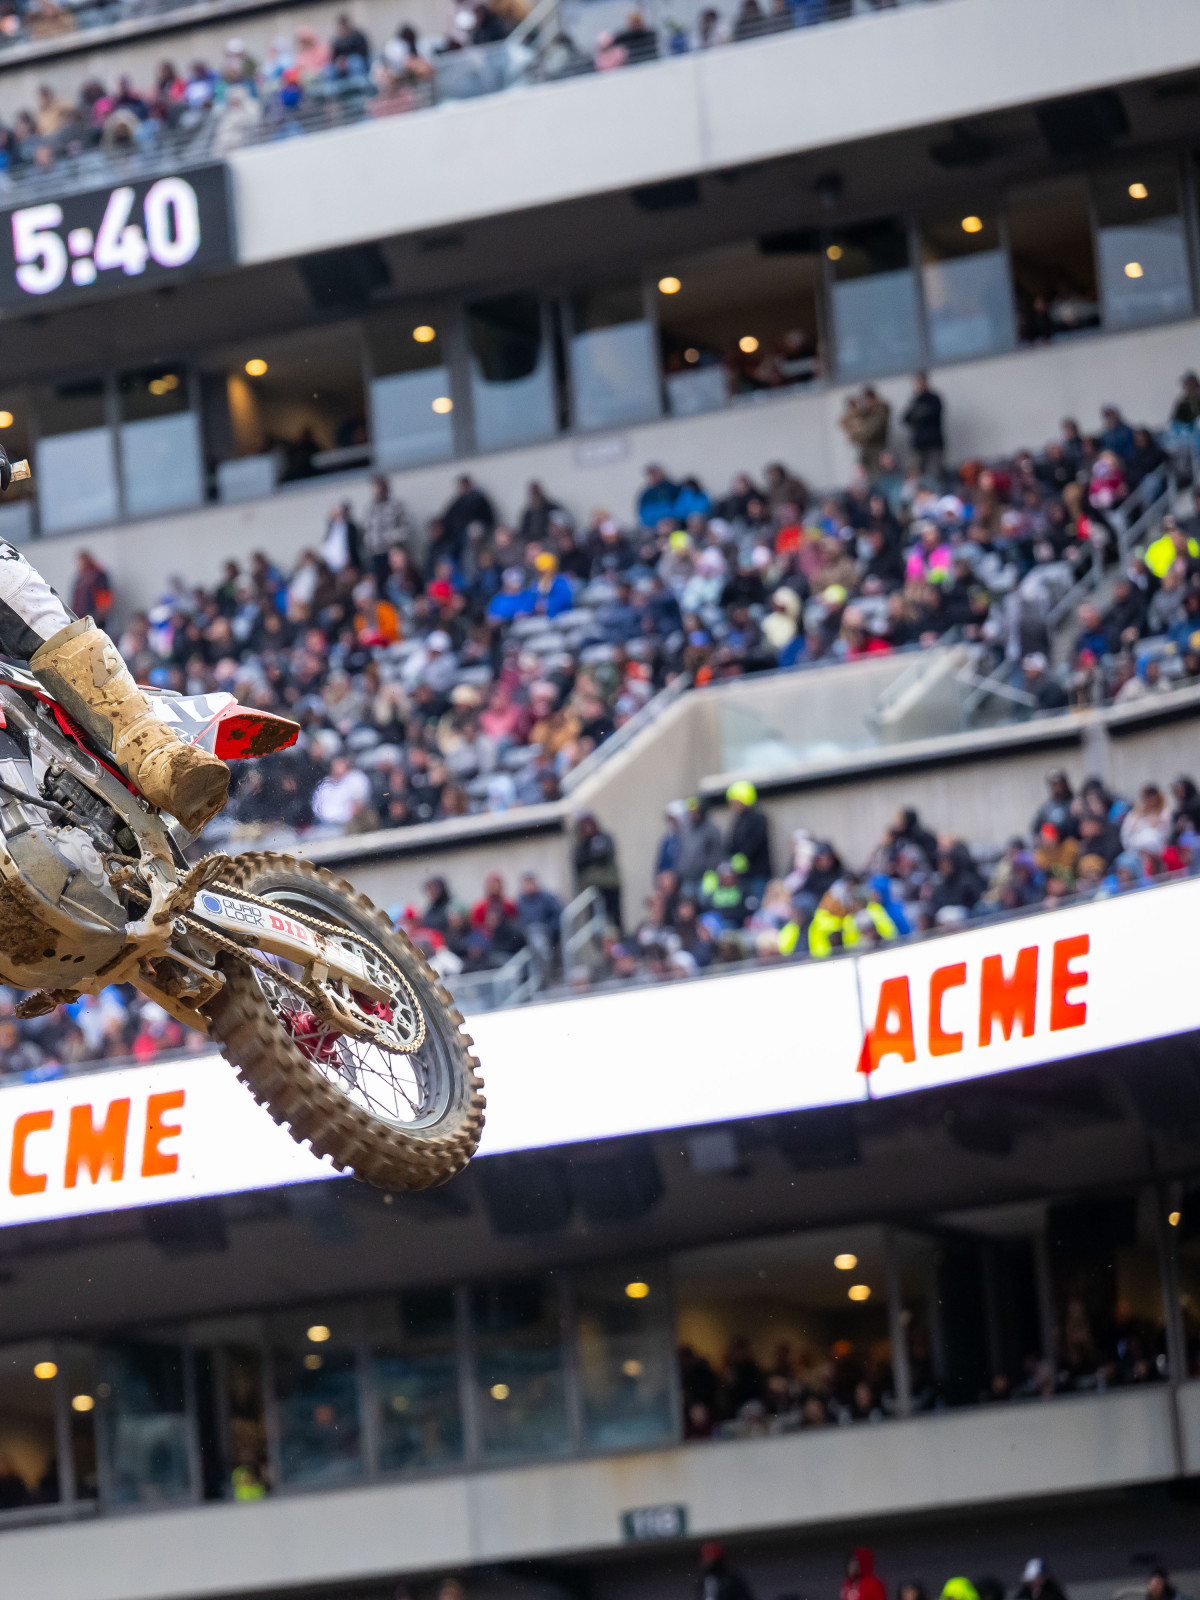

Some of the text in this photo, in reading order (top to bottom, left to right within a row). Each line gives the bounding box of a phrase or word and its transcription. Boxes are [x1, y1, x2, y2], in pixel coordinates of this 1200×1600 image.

[11, 177, 200, 294] 5:40
[222, 898, 262, 918] QUAD
[224, 908, 263, 928] LOCK
[857, 934, 1090, 1074] ACME
